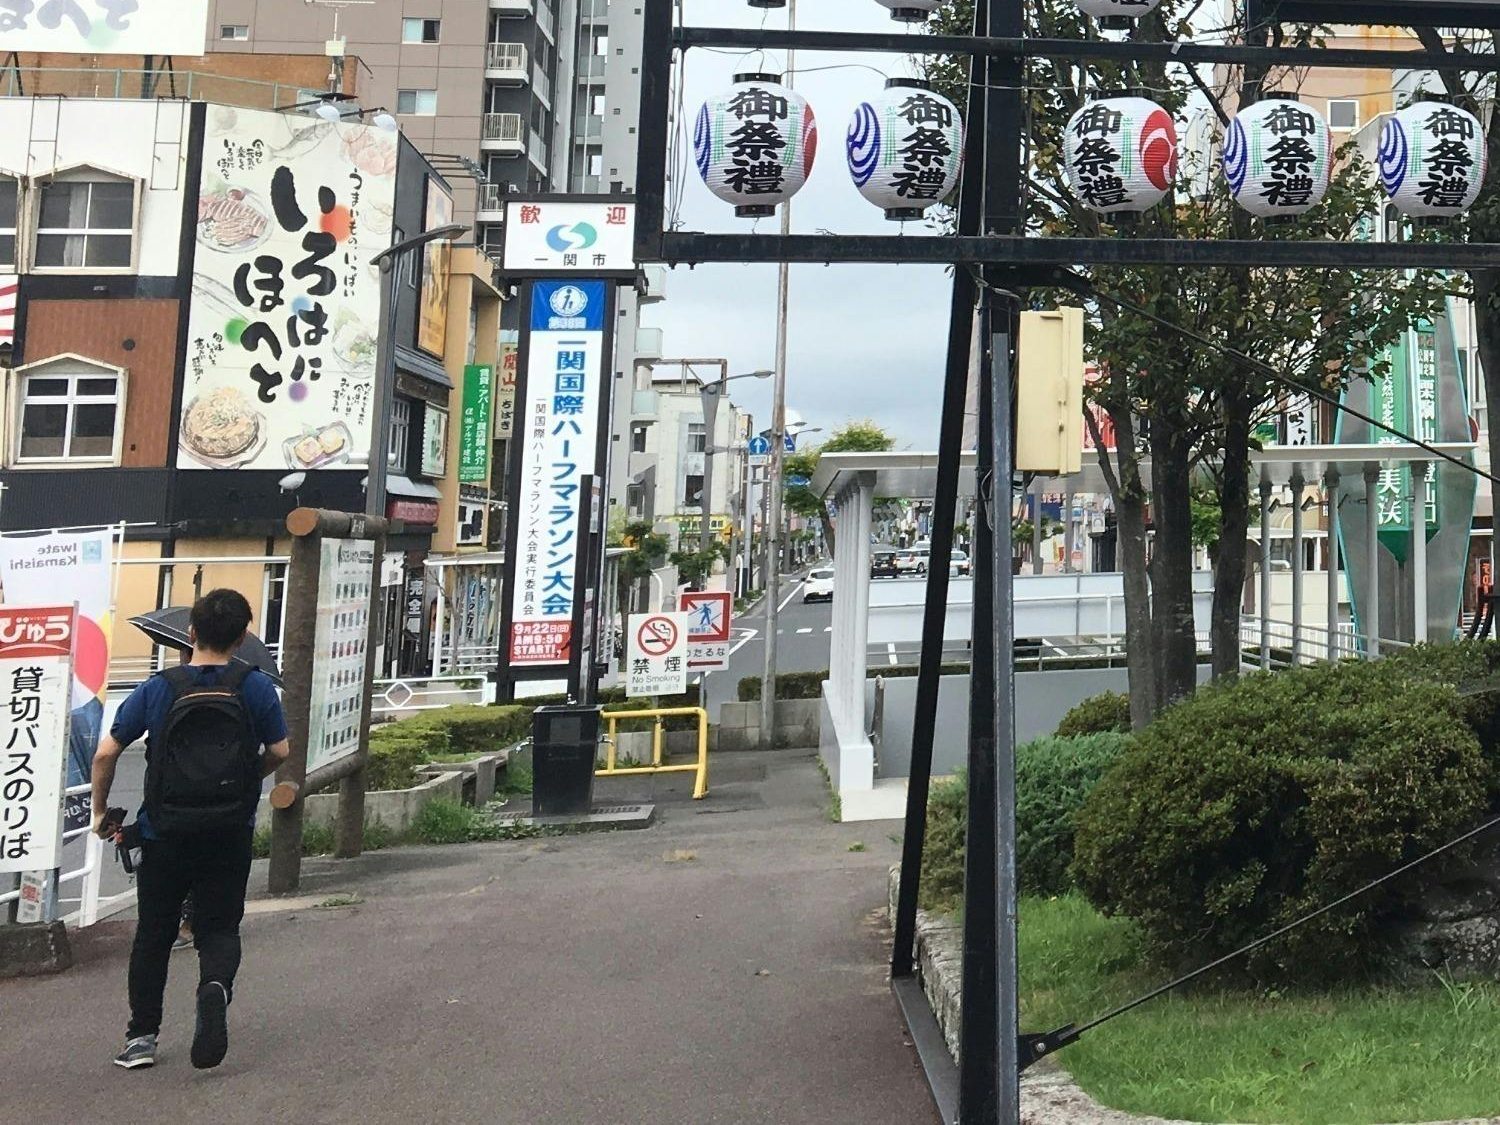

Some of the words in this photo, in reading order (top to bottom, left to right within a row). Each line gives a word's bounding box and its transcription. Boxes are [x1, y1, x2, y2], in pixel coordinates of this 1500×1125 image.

[724, 81, 788, 195] 御祭禮
[893, 93, 952, 199] 御祭禮
[1069, 102, 1127, 205] 御祭禮
[1262, 99, 1316, 208] 御祭禮
[1418, 106, 1473, 215] 御祭禮
[270, 164, 337, 382] いろはに
[534, 253, 606, 267] 一関市
[233, 254, 285, 404] ほへと
[541, 339, 588, 615] 一関国際ハーフマラソン大会
[632, 656, 681, 675] 禁煙
[646, 675, 680, 684] Smoking
[0, 665, 44, 860] 貸切バスのりば
